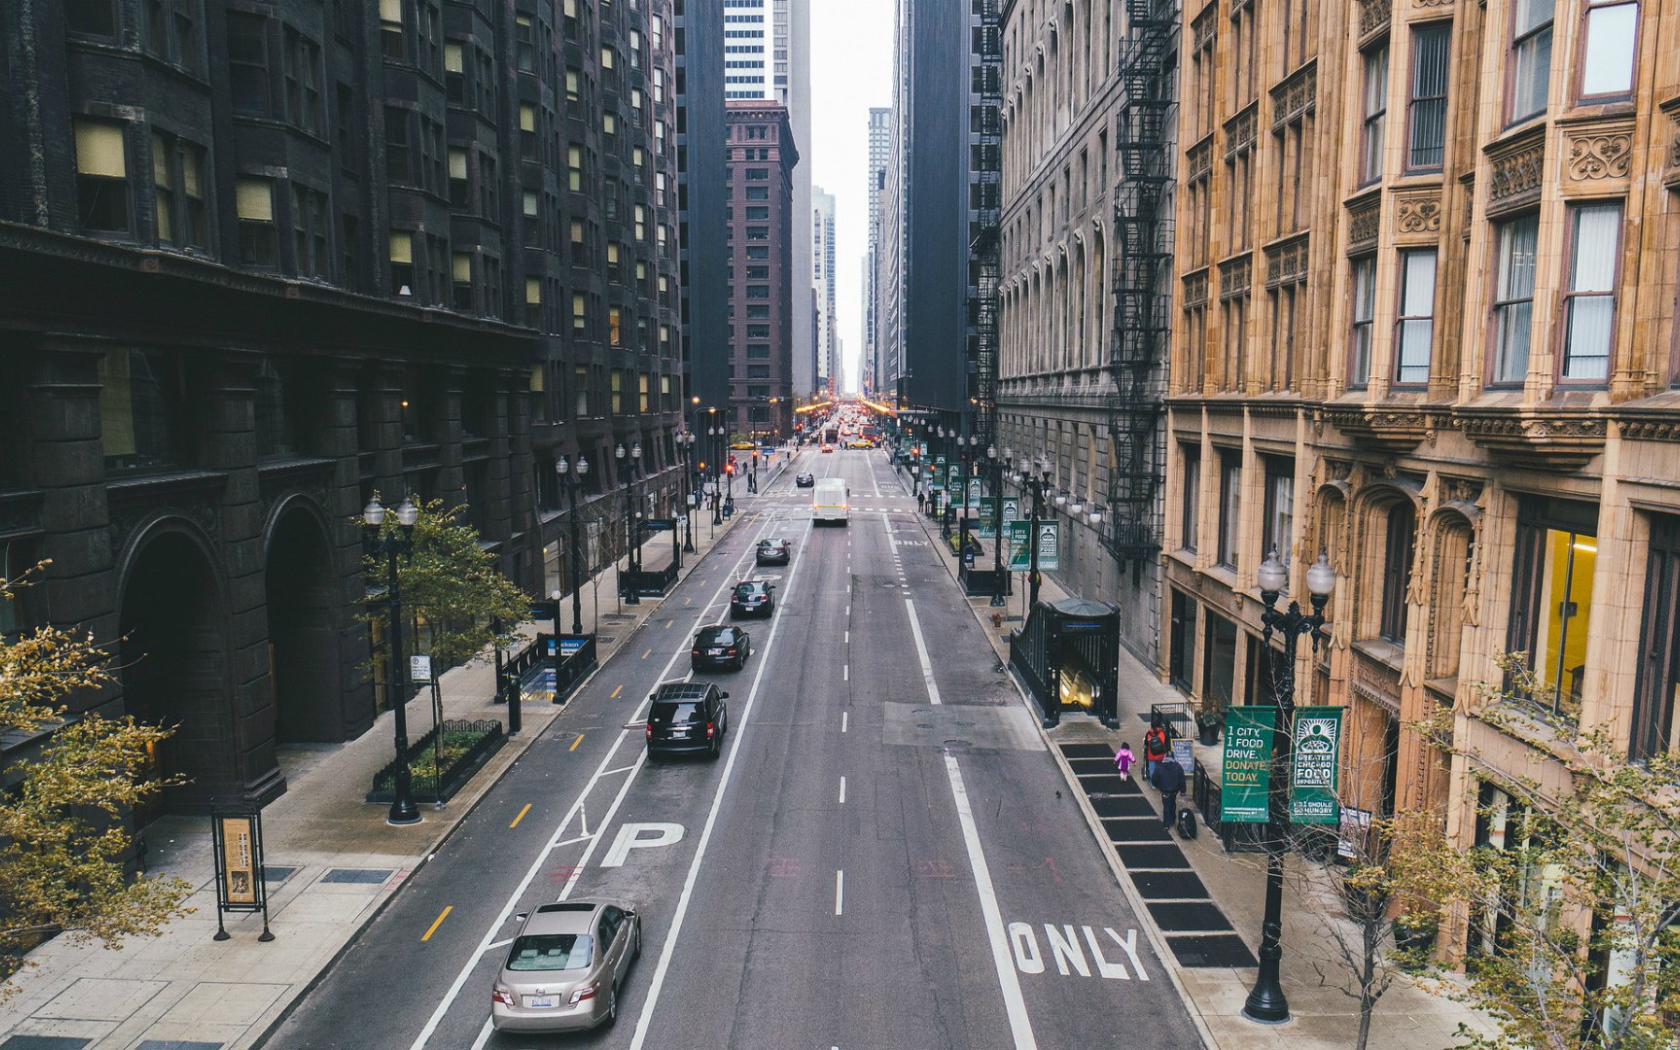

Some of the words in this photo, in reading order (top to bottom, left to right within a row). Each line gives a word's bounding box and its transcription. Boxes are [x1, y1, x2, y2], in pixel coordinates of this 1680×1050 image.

[1228, 726, 1234, 736] 1
[1227, 736, 1233, 747] 1
[1236, 738, 1264, 748] FOOD
[1226, 749, 1258, 759] DRIVE.
[1225, 760, 1265, 771] DONATE
[1297, 768, 1331, 779] FOOD
[600, 822, 685, 868] P
[1008, 921, 1150, 981] ONLY
